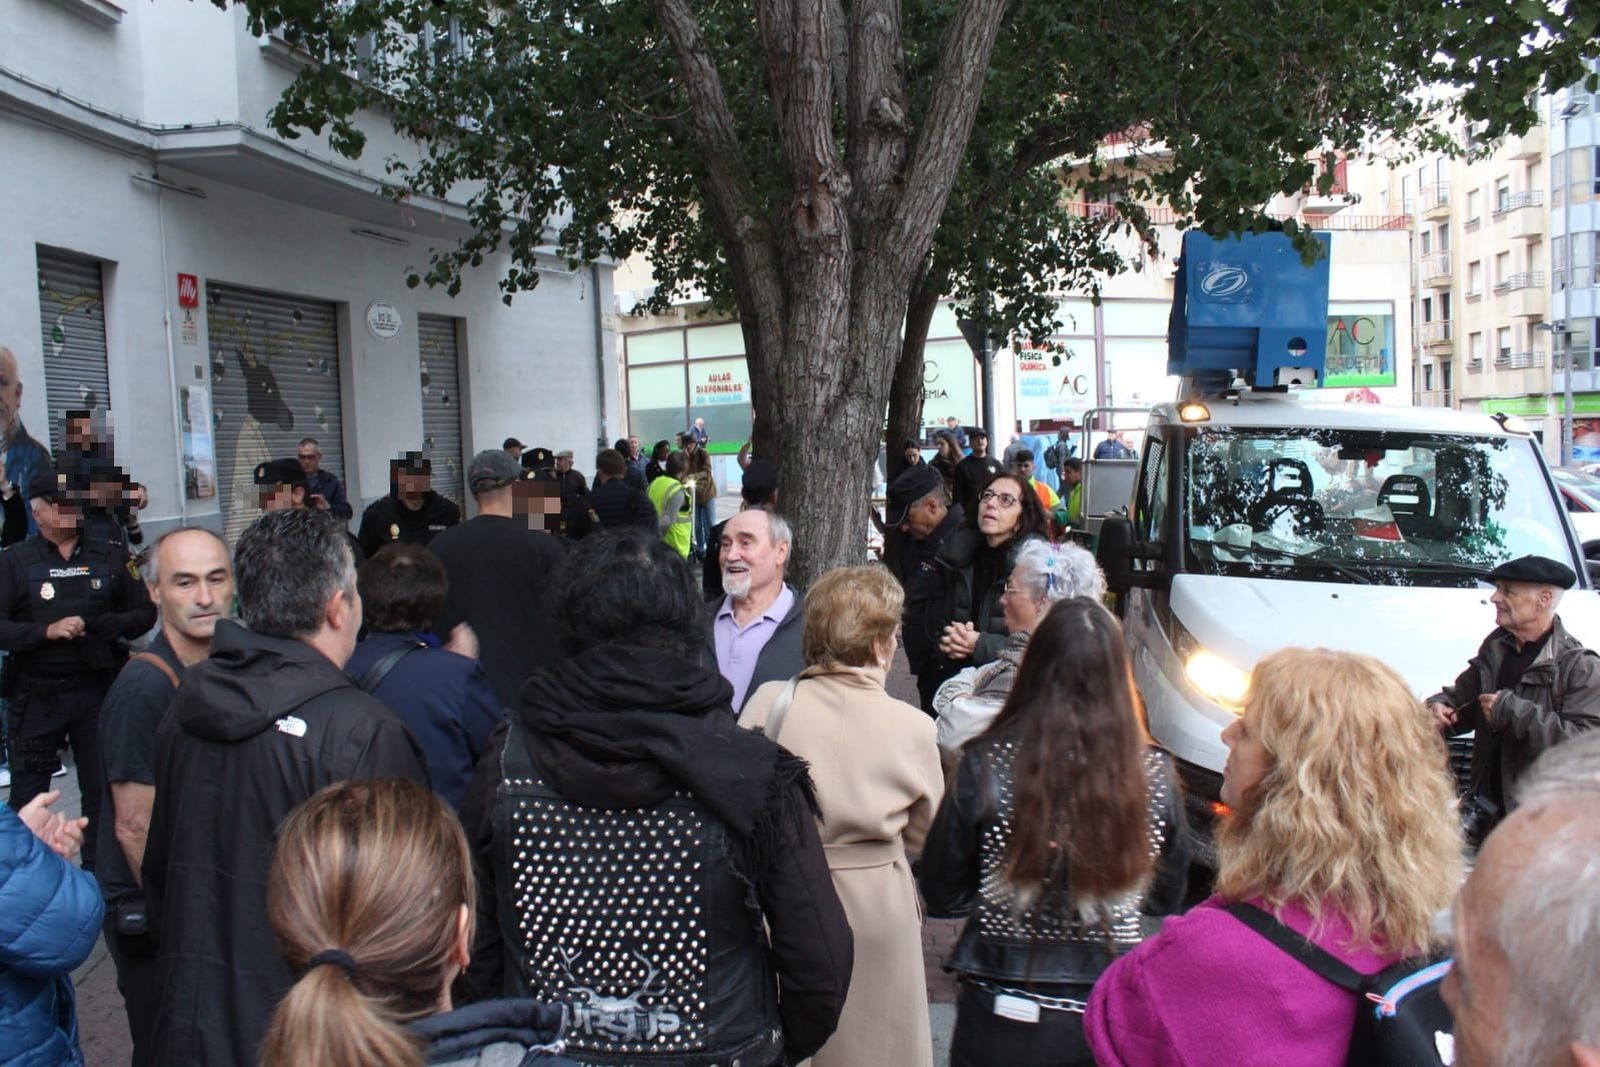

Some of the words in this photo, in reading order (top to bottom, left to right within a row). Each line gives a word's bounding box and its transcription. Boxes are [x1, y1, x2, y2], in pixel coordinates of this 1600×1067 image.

[180, 276, 197, 303] illy
[1329, 317, 1376, 345] AC
[923, 360, 939, 383] C
[1326, 355, 1389, 370] CADEMIA
[709, 372, 731, 382] AULAS
[1059, 374, 1088, 395] AC
